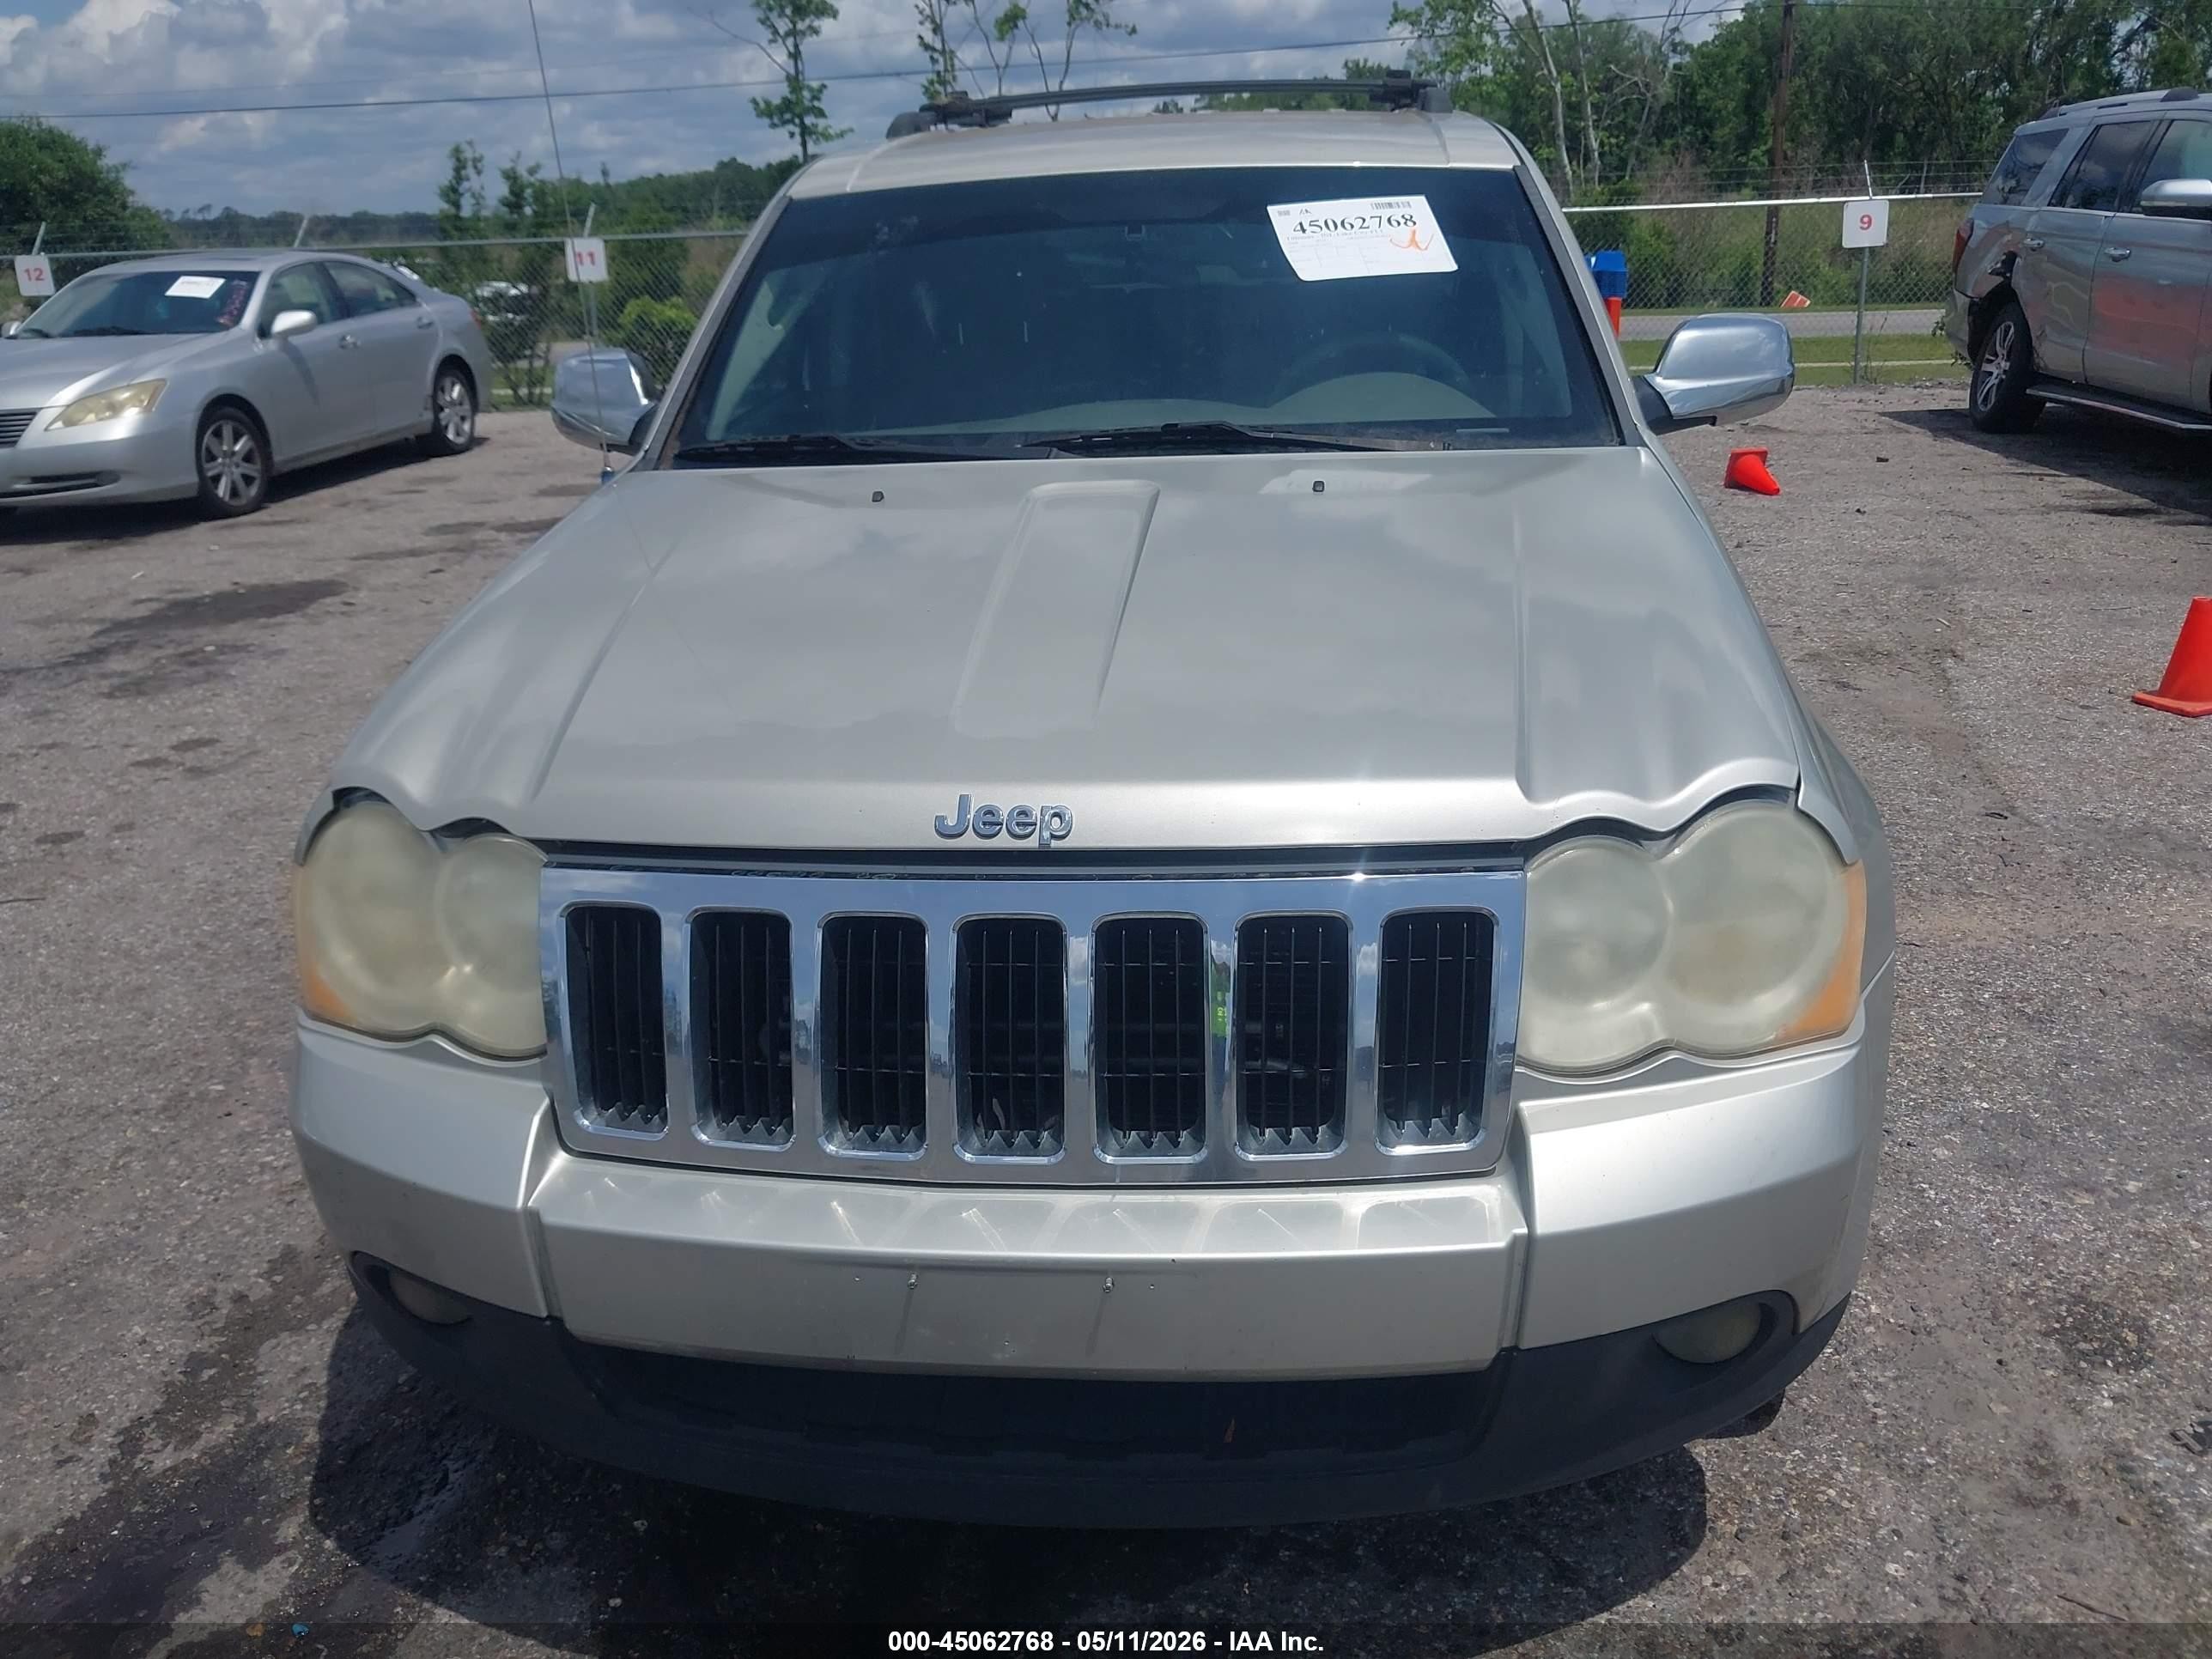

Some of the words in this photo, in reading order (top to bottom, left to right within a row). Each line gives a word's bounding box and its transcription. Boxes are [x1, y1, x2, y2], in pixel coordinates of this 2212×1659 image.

[1293, 213, 1417, 234] 45062768
[1859, 214, 1873, 231] 9
[575, 251, 596, 266] 11
[24, 267, 46, 282] 12
[934, 793, 1073, 847] Jeep
